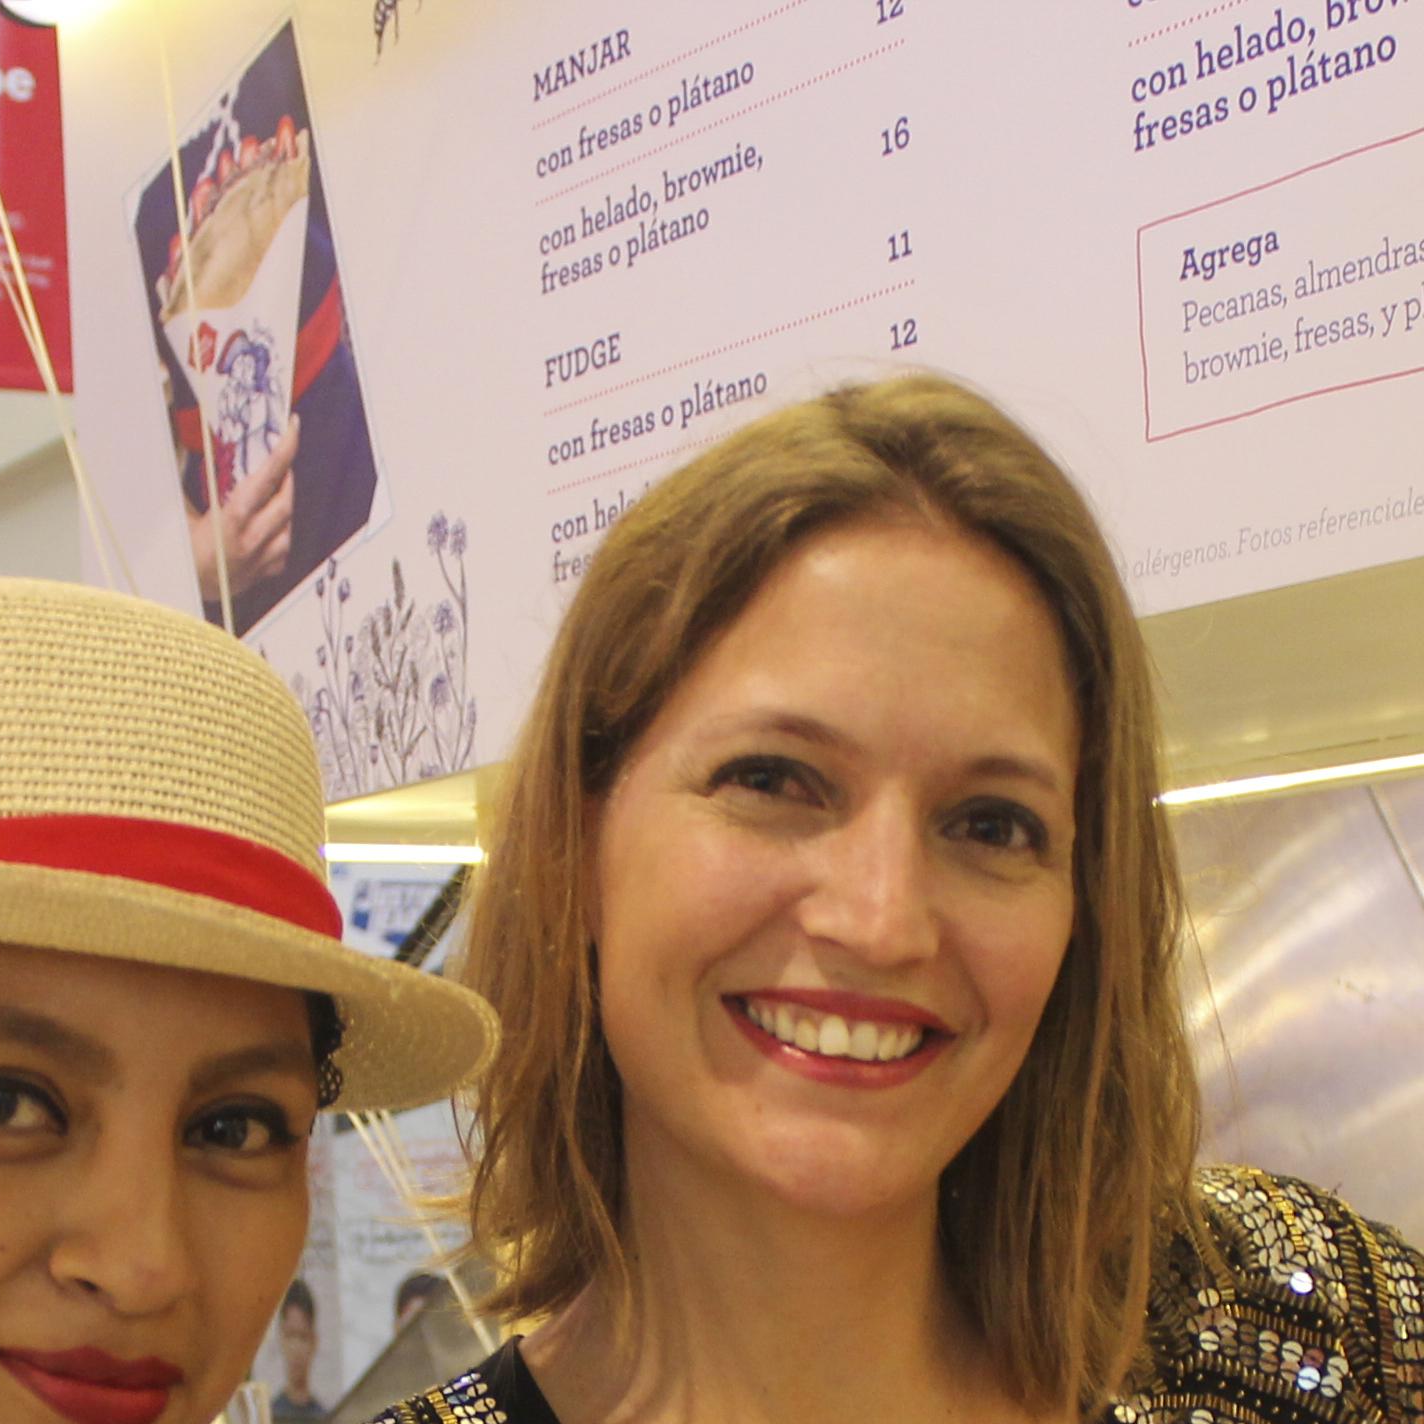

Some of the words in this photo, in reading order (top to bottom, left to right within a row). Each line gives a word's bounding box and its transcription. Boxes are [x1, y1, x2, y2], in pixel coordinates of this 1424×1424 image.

[532, 29, 632, 101] MANJAR
[1131, 61, 1187, 102] con
[1195, 9, 1316, 80] helado,
[536, 147, 574, 179] con
[579, 112, 643, 161] fresas
[649, 103, 661, 127] o
[668, 61, 755, 127] plátano
[1133, 96, 1229, 152] fresas
[1239, 86, 1256, 112] o
[1267, 34, 1397, 114] plátano
[880, 117, 910, 156] 16
[539, 226, 576, 257] con
[581, 184, 658, 239] helado,
[663, 143, 764, 203] brownie,
[540, 248, 603, 296] fresas
[608, 244, 620, 267] o
[626, 207, 710, 268] plátano
[888, 231, 913, 262] 11
[1179, 230, 1279, 282] Agrega
[890, 319, 917, 351] 12
[1182, 283, 1288, 332] Pecanas,
[545, 333, 622, 388] FUDGE
[1183, 332, 1289, 385] brownie,
[1294, 310, 1375, 356] fresas,
[1380, 304, 1398, 337] y
[548, 436, 585, 466] con
[591, 411, 655, 452] fresas
[661, 405, 674, 427] o
[680, 371, 767, 429] plátano
[551, 514, 588, 543] con
[1236, 525, 1292, 556] Fotos
